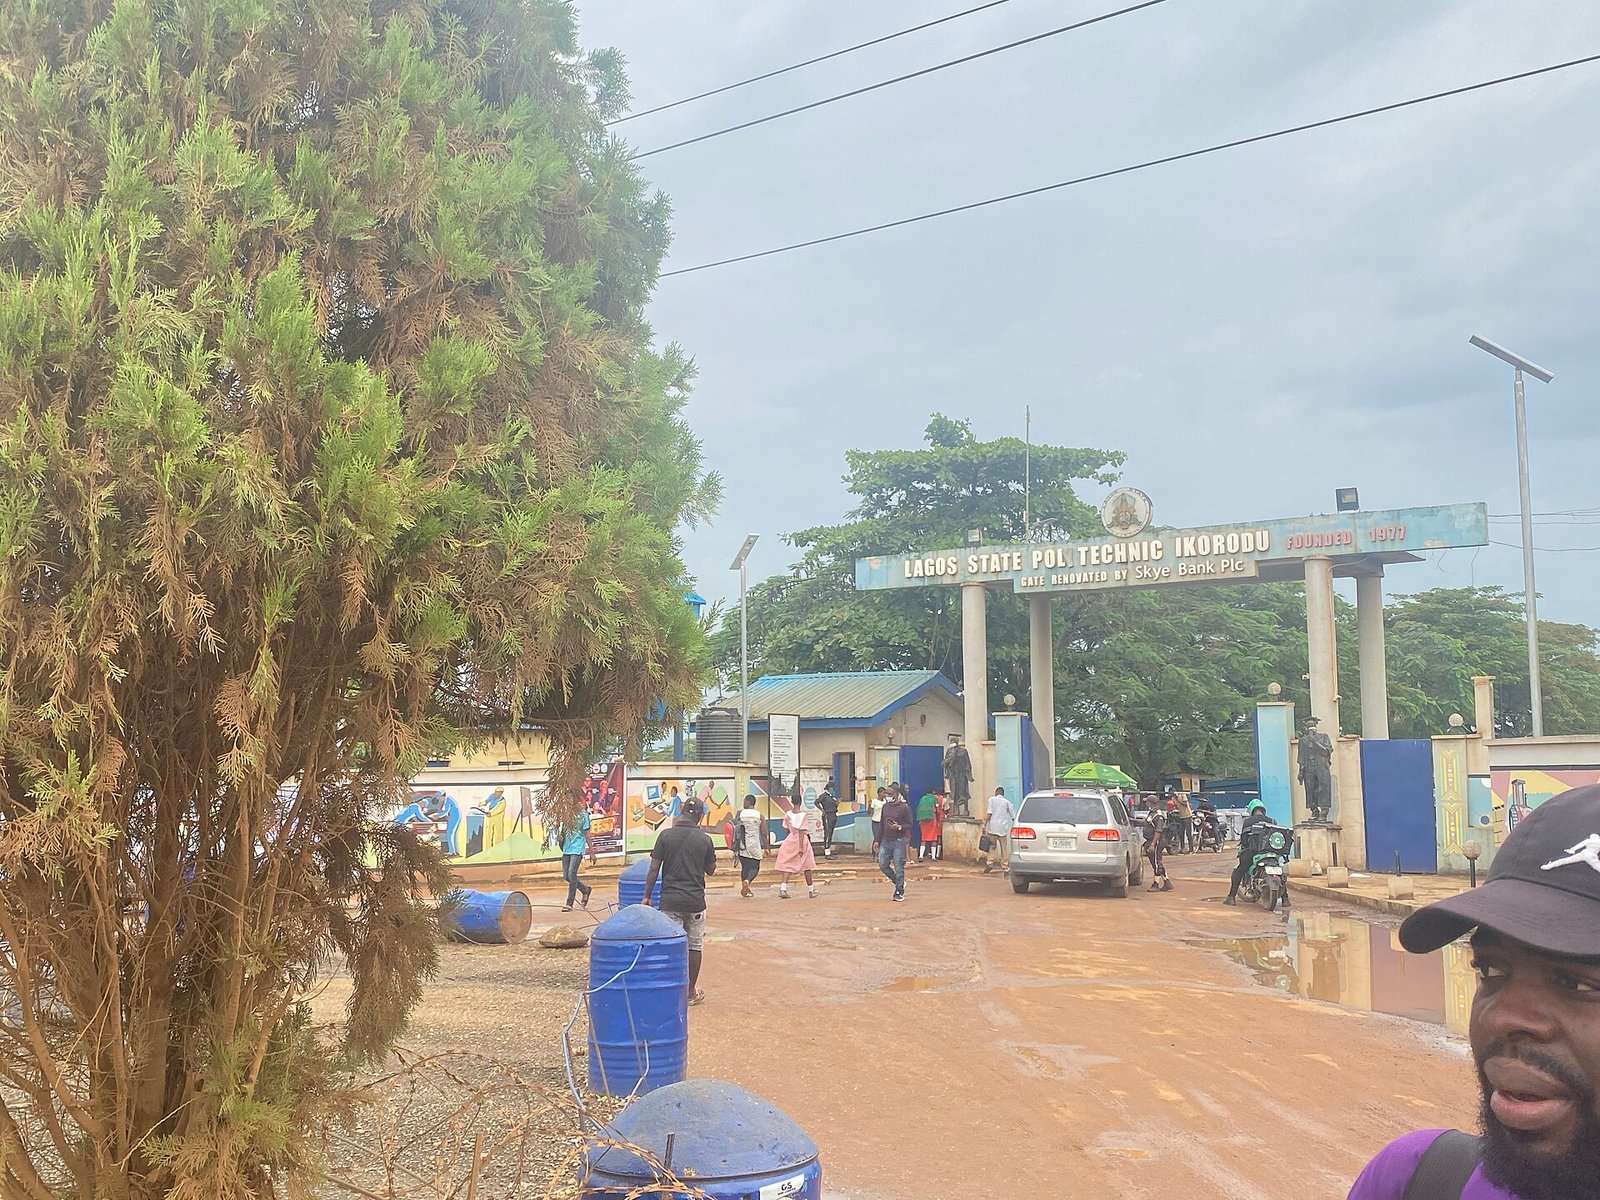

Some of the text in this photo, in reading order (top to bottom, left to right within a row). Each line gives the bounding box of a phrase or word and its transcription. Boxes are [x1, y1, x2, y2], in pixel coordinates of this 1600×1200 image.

[904, 556, 957, 578] LAGOS
[968, 552, 1022, 574] STATE
[1175, 530, 1269, 557] IKORODU
[1287, 531, 1352, 549] FOUNDED
[1369, 526, 1406, 542] 1977
[1021, 558, 1244, 587] GATE RENOVATED BY Skye Bank Plc
